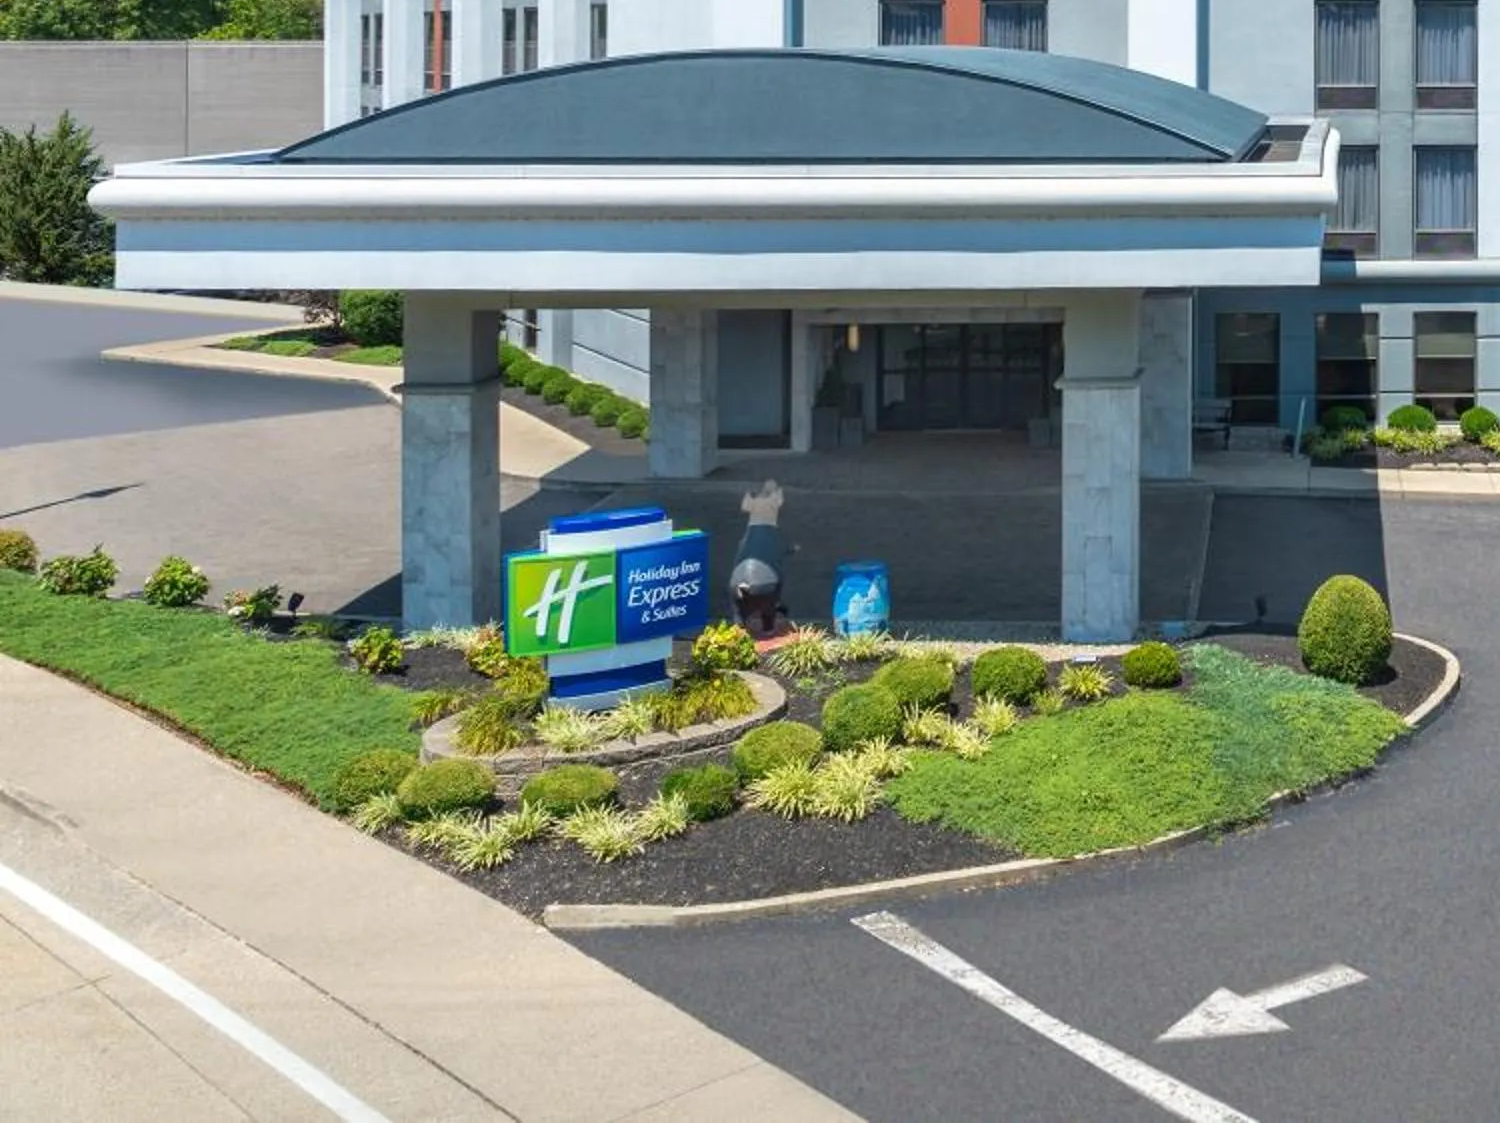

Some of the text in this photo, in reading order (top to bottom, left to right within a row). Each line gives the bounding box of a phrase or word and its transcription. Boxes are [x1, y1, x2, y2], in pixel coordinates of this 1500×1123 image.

[628, 560, 701, 584] Holiday Inn
[524, 560, 613, 643] H
[628, 579, 701, 608] Express
[641, 604, 687, 624] & Suites
